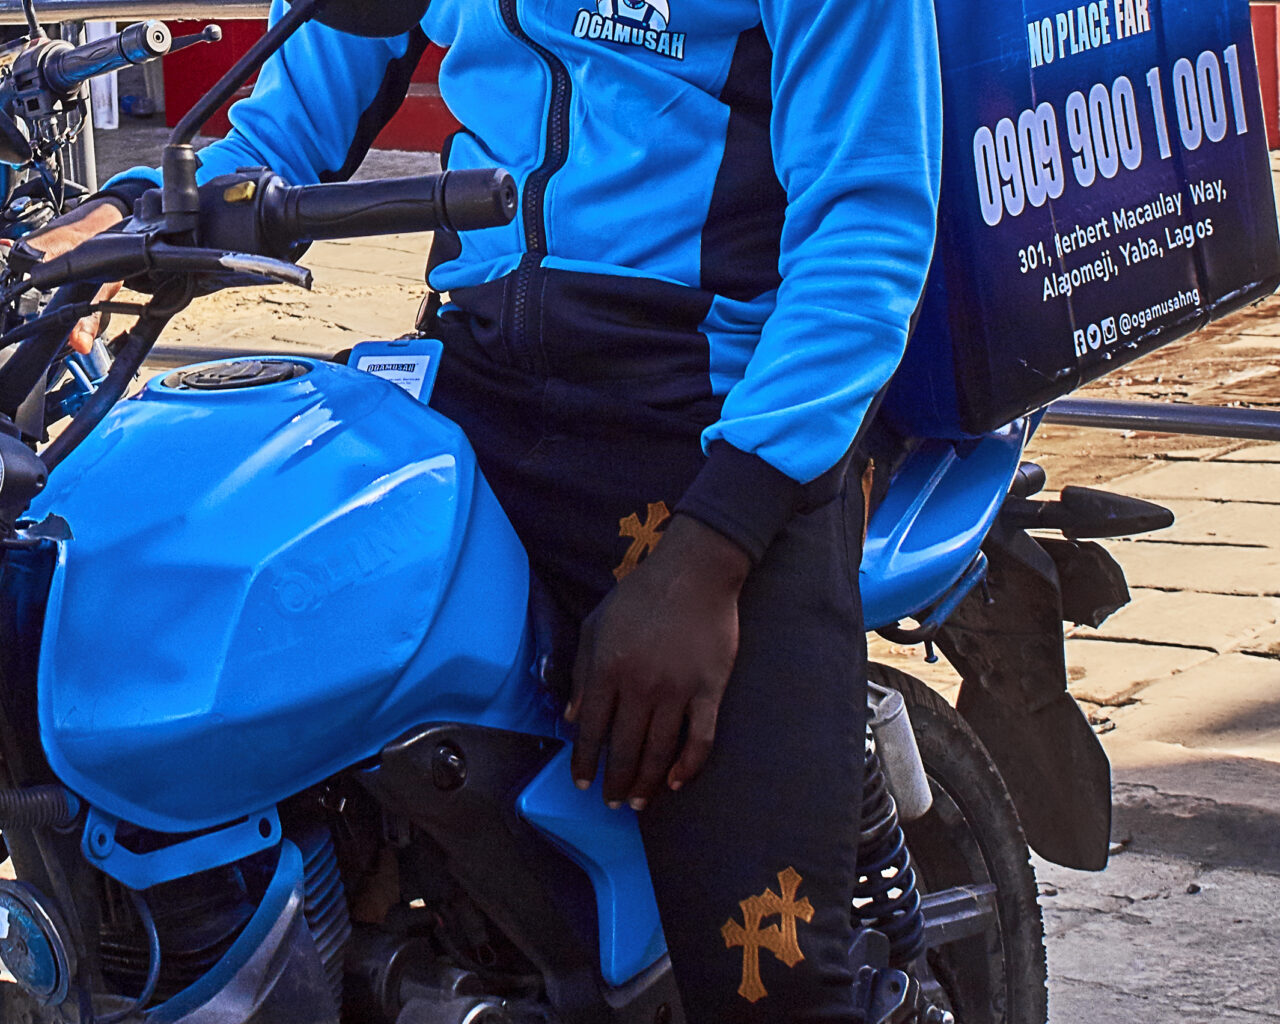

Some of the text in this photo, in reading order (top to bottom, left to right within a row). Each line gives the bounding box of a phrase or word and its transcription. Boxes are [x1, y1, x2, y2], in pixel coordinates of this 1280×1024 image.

[574, 10, 685, 60] OGAMUSAH
[1028, 20, 1055, 68] NO
[1056, 0, 1110, 59] PLACE
[973, 101, 1065, 226] 0909
[1065, 75, 1144, 188] 900
[1018, 241, 1053, 274] 301,
[1112, 192, 1182, 234] Macaulay
[1190, 178, 1228, 206] Way,
[1119, 237, 1164, 267] Yaba,
[1165, 217, 1214, 250] Lagos
[1119, 288, 1201, 336] @ogamusahng
